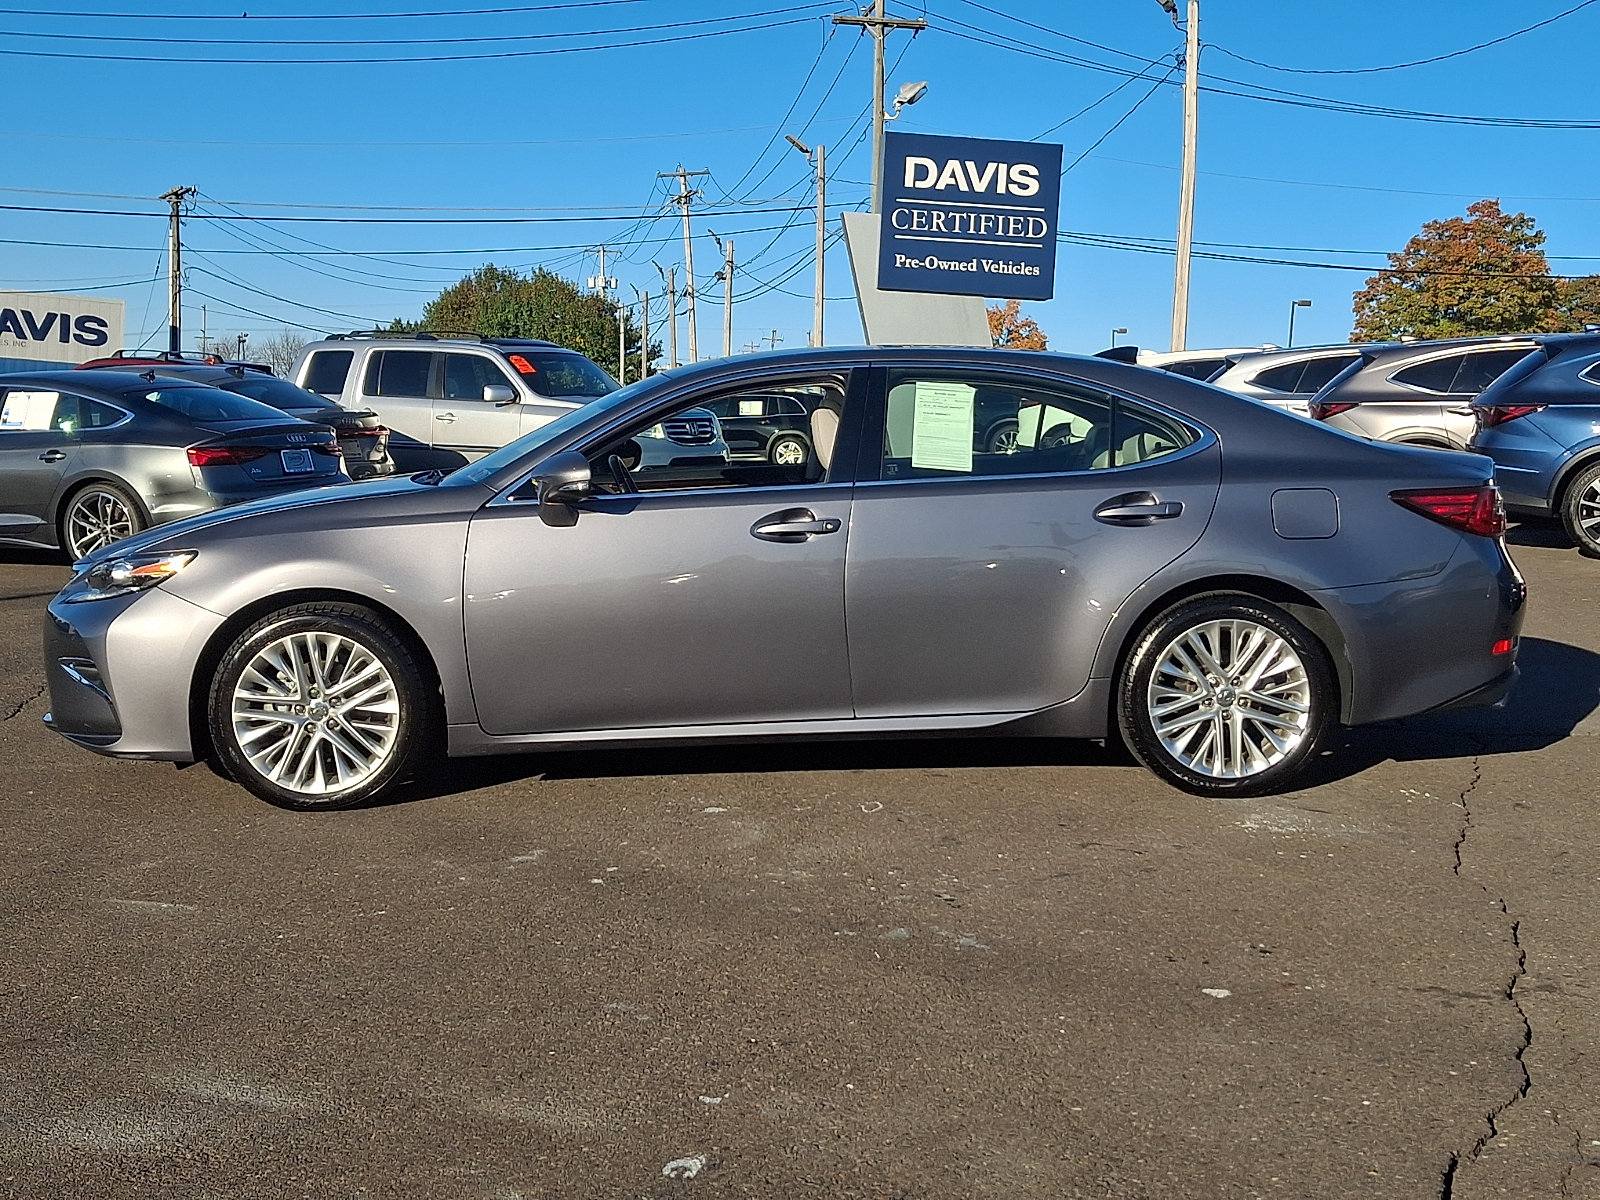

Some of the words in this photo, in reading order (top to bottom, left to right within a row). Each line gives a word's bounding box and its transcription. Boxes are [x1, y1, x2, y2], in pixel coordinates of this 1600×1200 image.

[904, 156, 1040, 196] DAVIS
[891, 208, 1048, 239] CERTIFIED
[895, 253, 977, 272] Pre-Owned
[981, 258, 1040, 276] Vehicles
